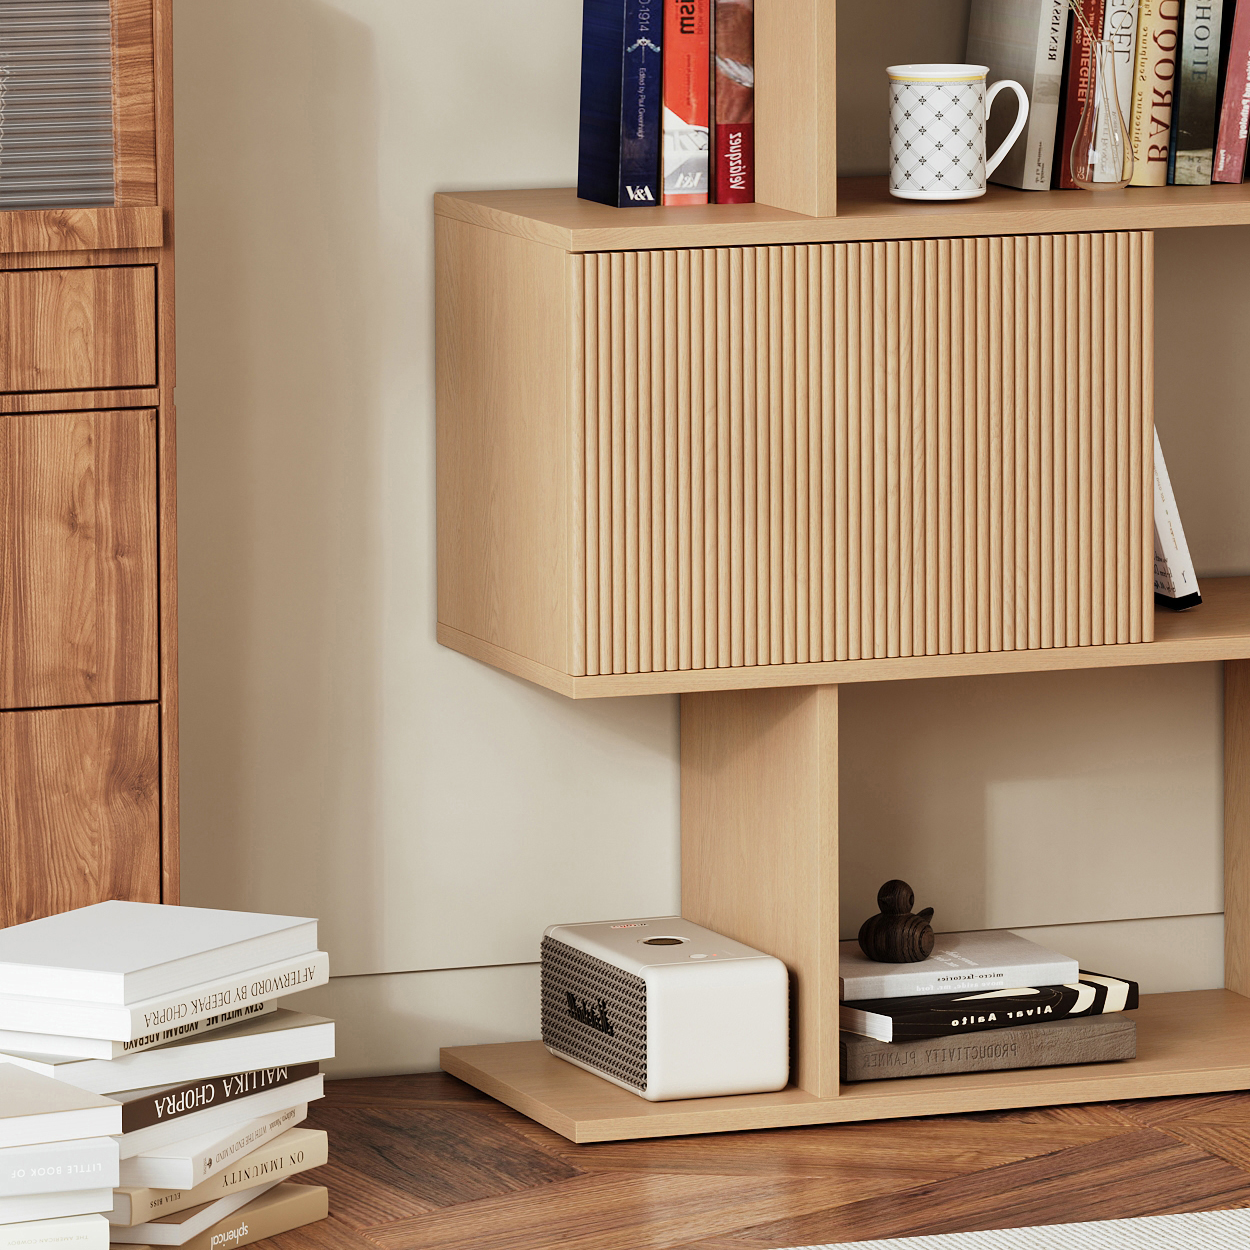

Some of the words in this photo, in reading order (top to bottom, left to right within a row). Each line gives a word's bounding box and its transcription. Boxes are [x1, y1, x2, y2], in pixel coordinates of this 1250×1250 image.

[638, 67, 646, 86] Edited
[637, 87, 646, 95] by
[626, 185, 654, 200] V&A
[251, 966, 316, 997] AFTERWORD
[191, 989, 231, 1014] DEEPAK
[235, 985, 248, 1003] BY
[144, 1003, 188, 1027] CHOPRA
[222, 1008, 244, 1022] WITH
[244, 1003, 264, 1015] STAY
[206, 1016, 219, 1026] ME
[223, 1067, 288, 1097] MALLIKA
[154, 1083, 214, 1118] CHOPRA
[235, 1139, 245, 1151] END
[246, 1133, 254, 1145] THE
[216, 1148, 228, 1163] MIND
[289, 1151, 304, 1166] ON
[11, 1169, 26, 1178] OF
[30, 1166, 62, 1177] BOOK
[67, 1163, 102, 1174] LITTLE
[222, 1157, 283, 1187] IMMUNITY
[150, 1197, 163, 1208] BISS
[164, 1192, 181, 1203] EULA
[210, 1222, 249, 1250] spherical
